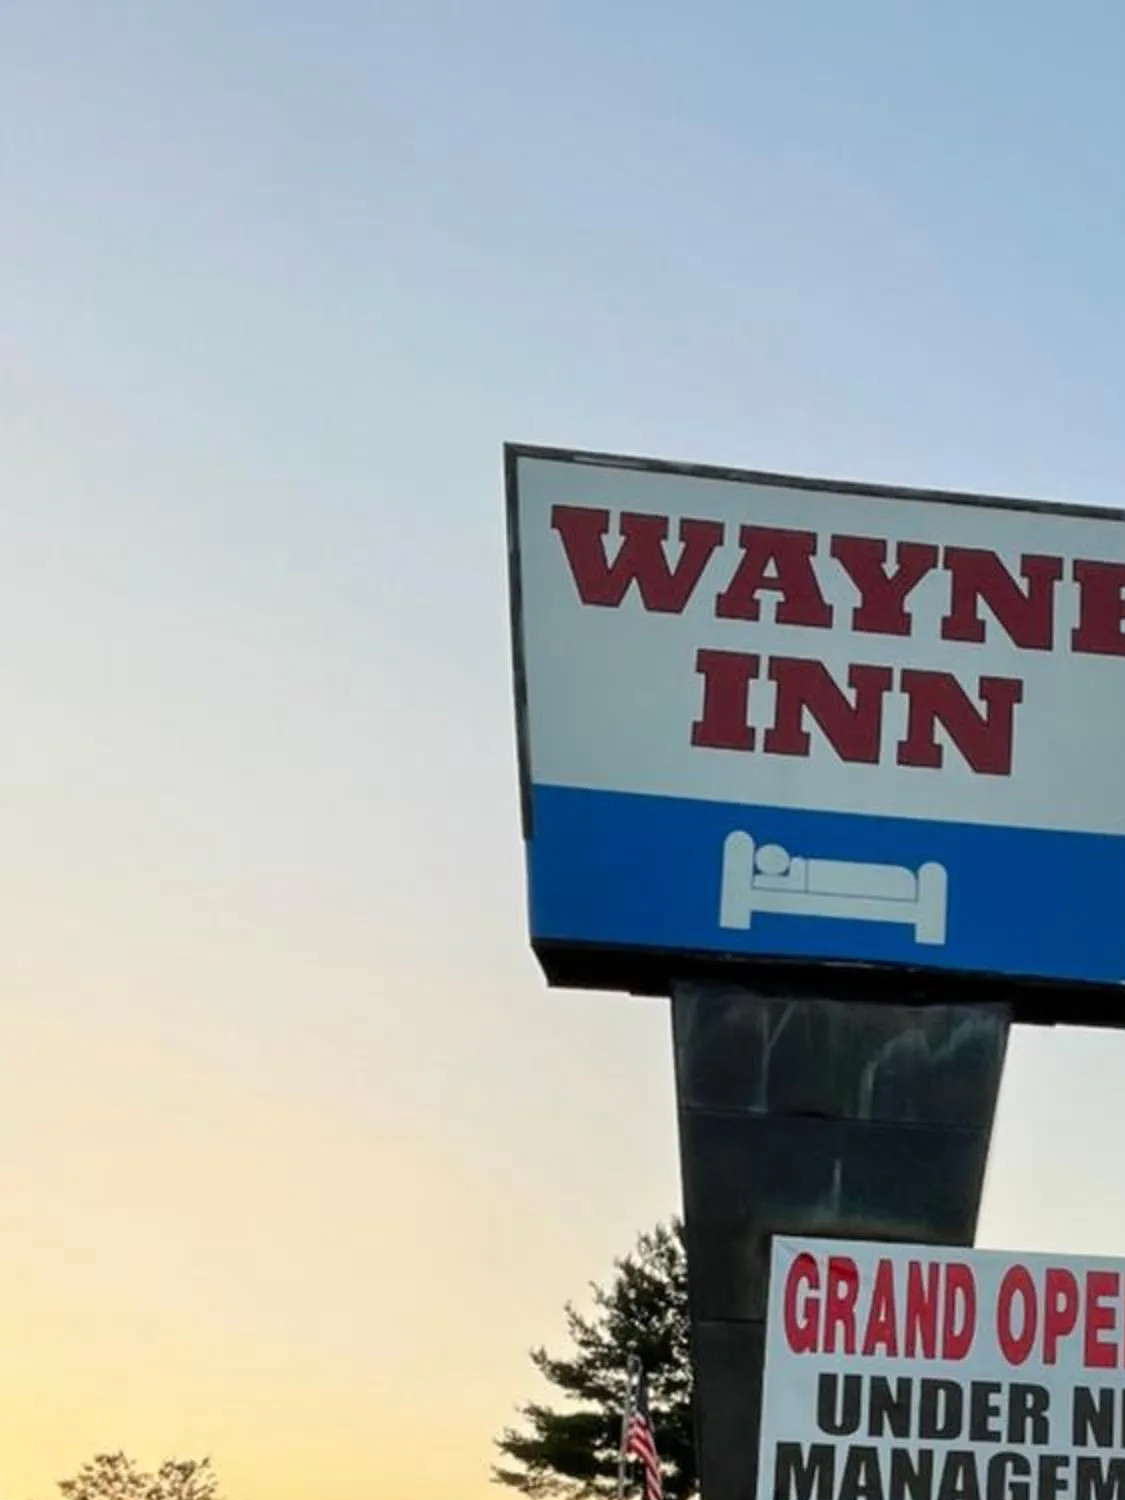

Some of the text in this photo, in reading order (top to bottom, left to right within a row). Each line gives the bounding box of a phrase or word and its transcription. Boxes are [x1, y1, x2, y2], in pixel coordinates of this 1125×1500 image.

[691, 648, 1023, 776] INN
[783, 1251, 977, 1361] GRAND
[816, 1372, 1051, 1446] UNDER
